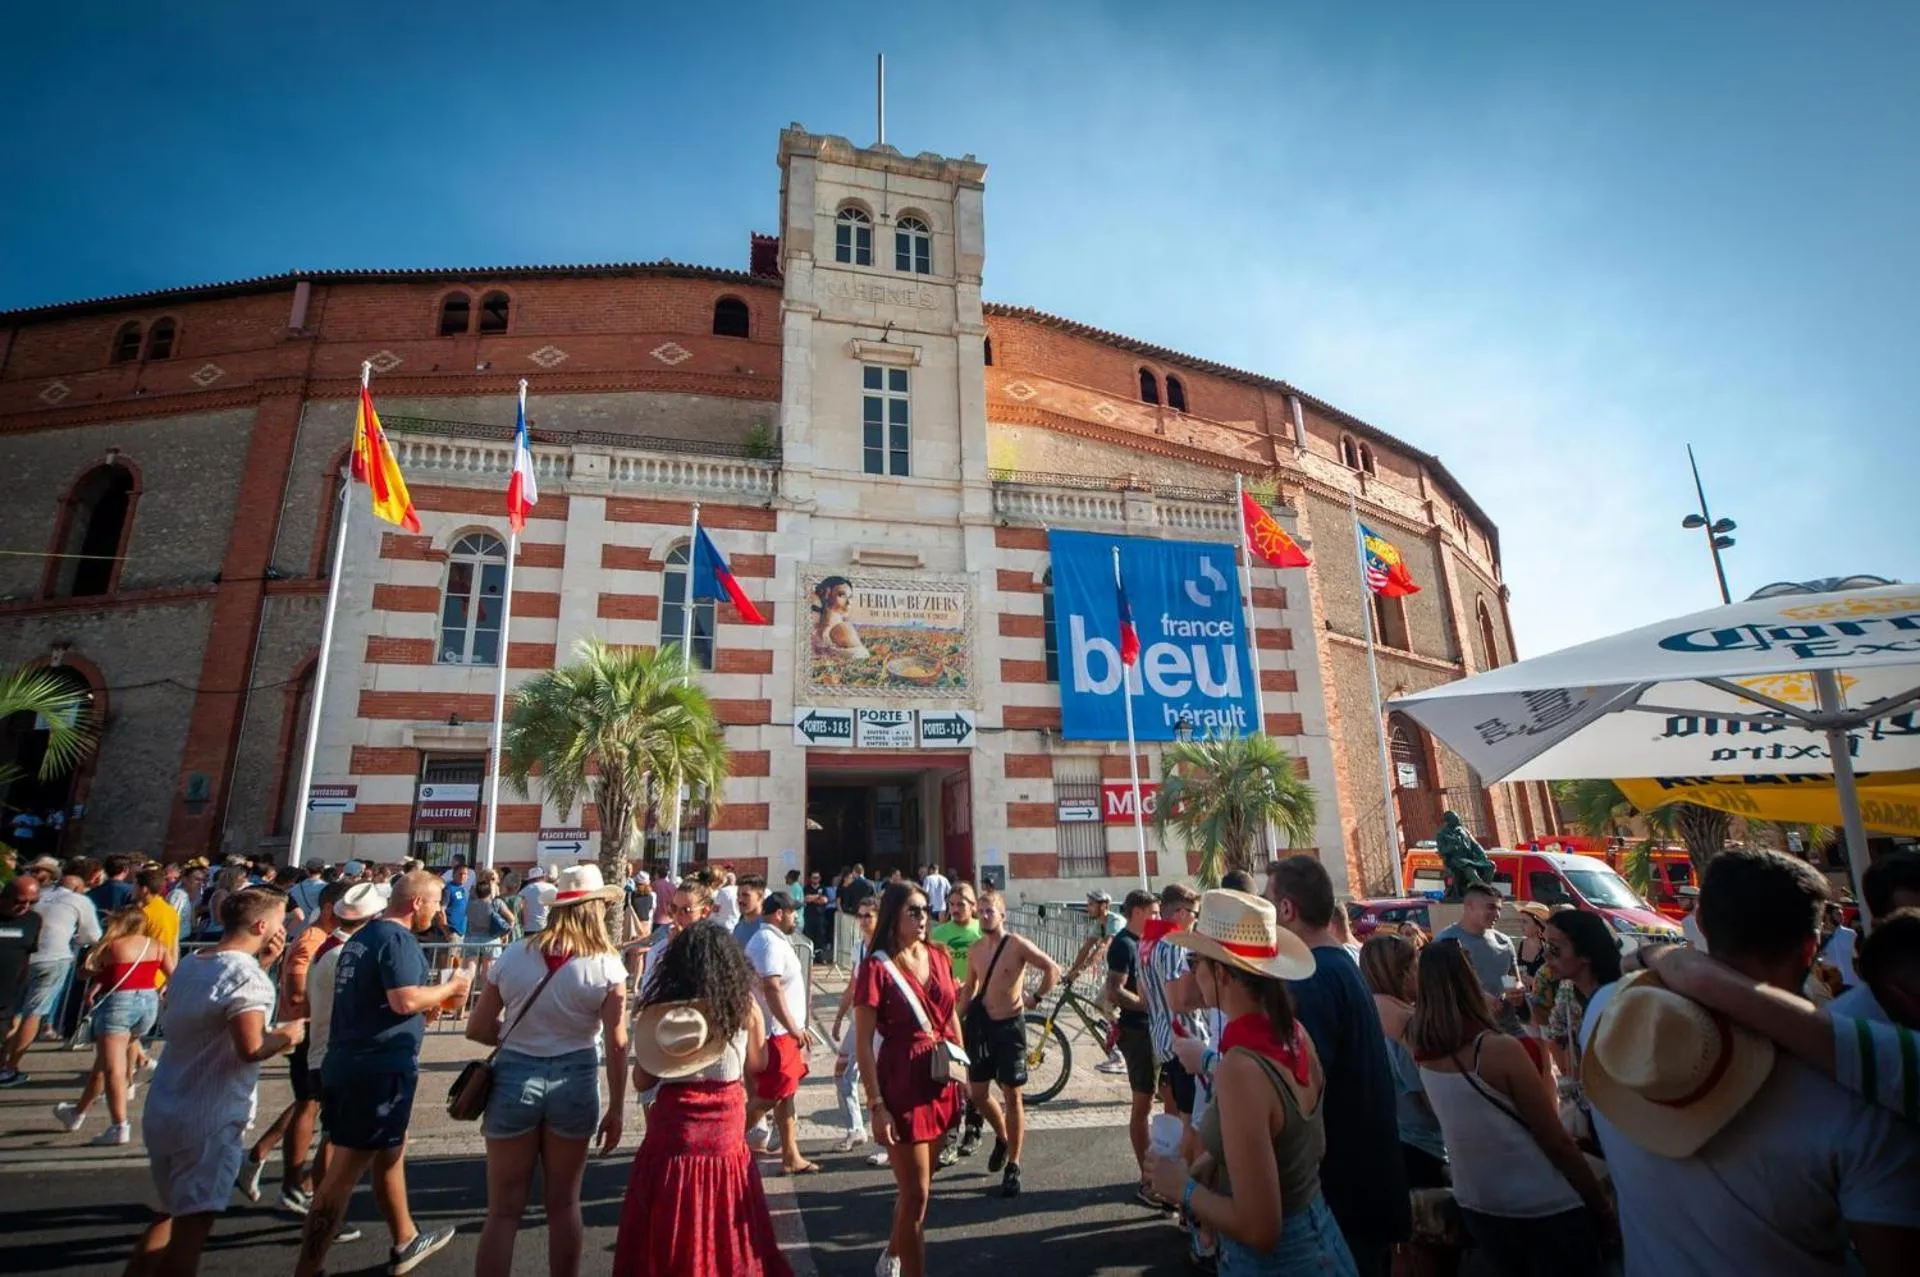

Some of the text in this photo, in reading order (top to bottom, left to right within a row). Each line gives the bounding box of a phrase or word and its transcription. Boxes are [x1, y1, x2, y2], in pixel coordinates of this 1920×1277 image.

[1160, 612, 1235, 637] france
[860, 710, 913, 721] PORTE 1
[1163, 702, 1247, 728] hérault
[803, 720, 827, 733] PORTES
[924, 722, 946, 735] PORTES
[421, 807, 472, 817] BILLETTERIE
